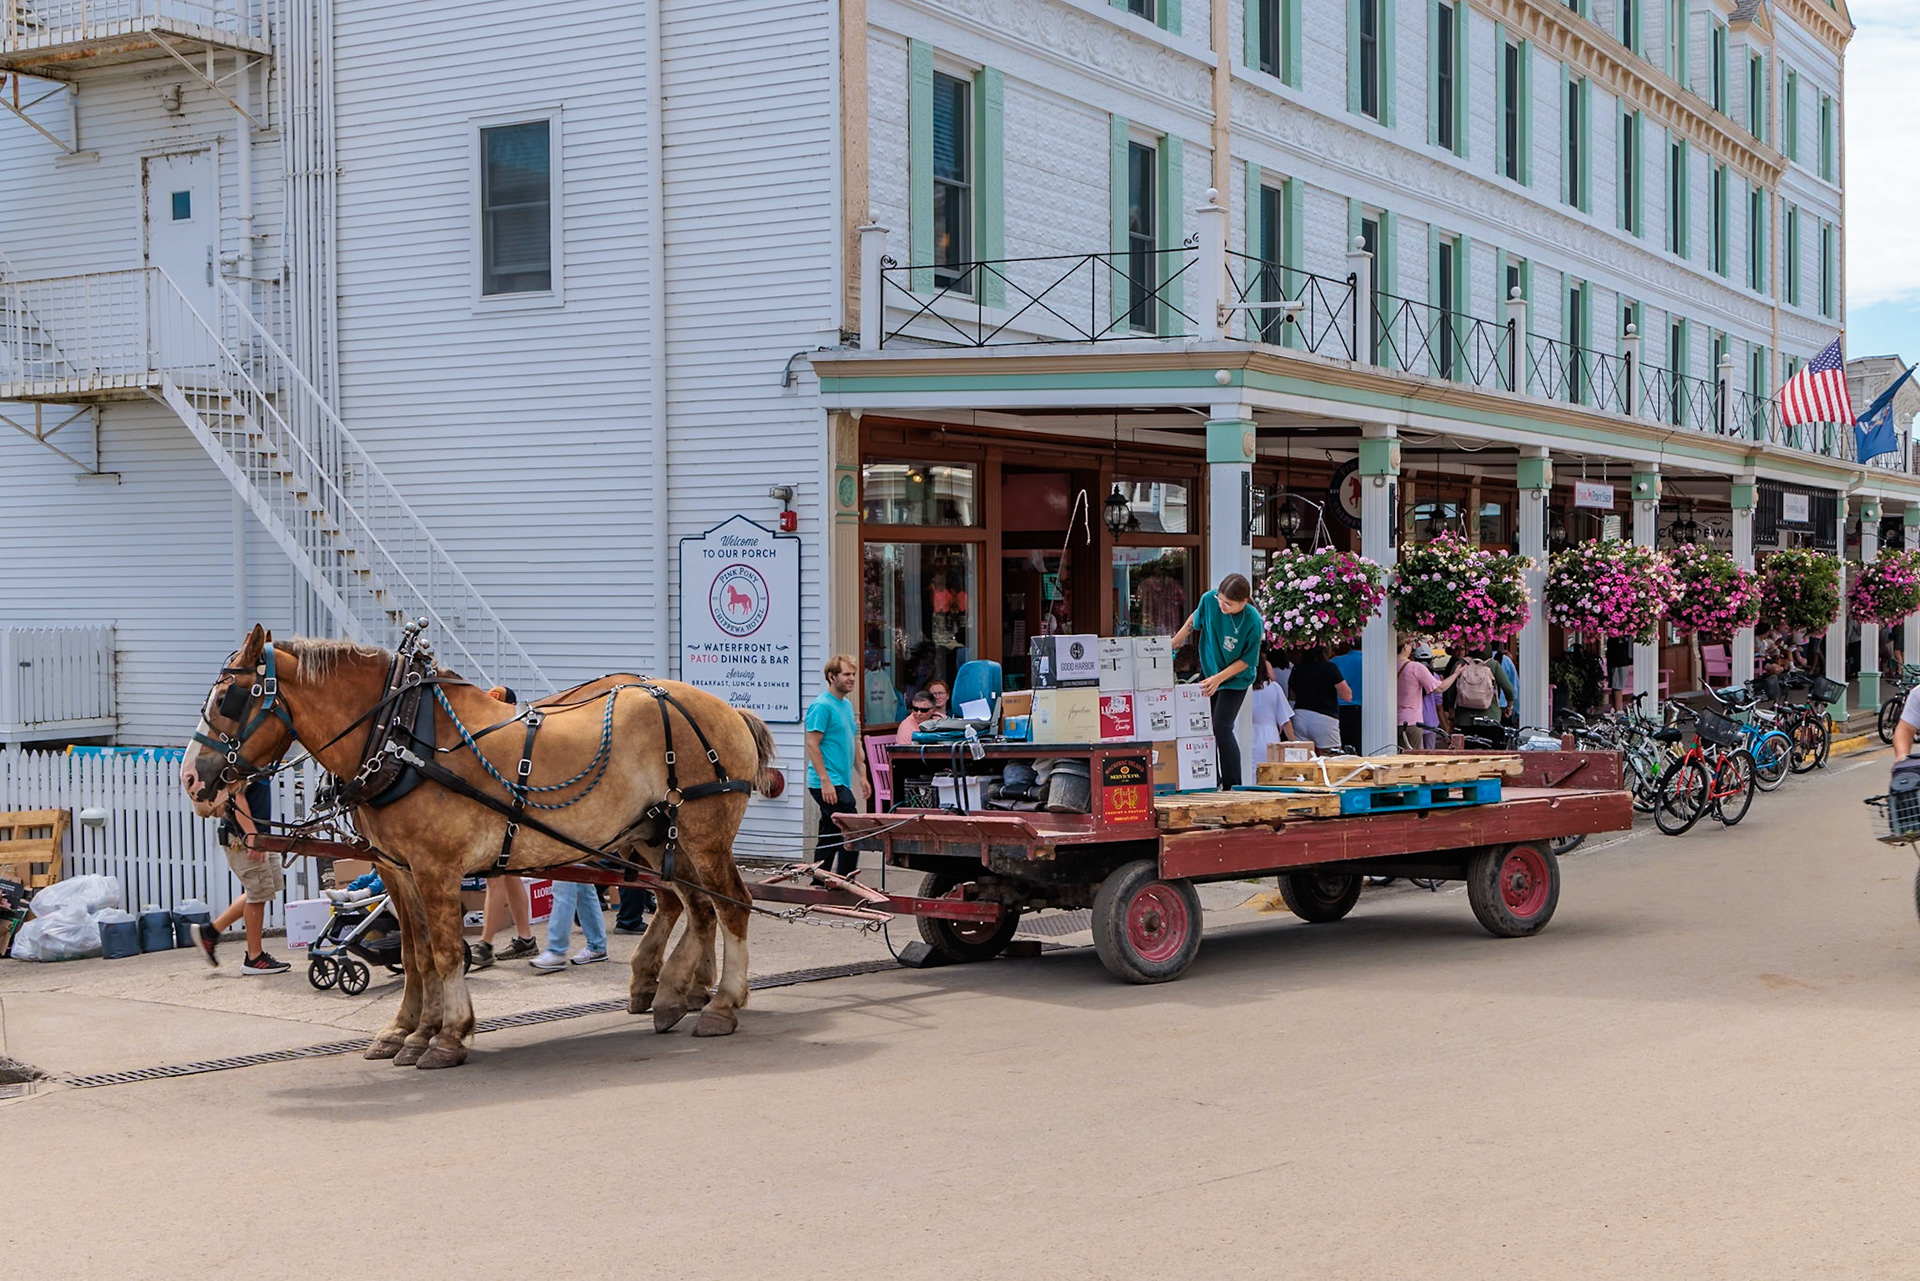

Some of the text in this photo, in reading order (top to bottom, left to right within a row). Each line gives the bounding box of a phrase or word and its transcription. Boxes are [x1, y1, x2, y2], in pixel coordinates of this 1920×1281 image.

[720, 535, 760, 546] Welcome
[702, 549, 776, 558] TO OUR PORCH
[719, 567, 759, 584] PINK PONY
[714, 608, 764, 632] CHIPPEWA HOTEL
[704, 643, 772, 652] WATERFRONT
[690, 654, 790, 664] PATIO DINING & BAR
[1060, 662, 1095, 672] GOOD HARBOR
[726, 668, 755, 681] Serving
[692, 680, 730, 688] BREAKFAST,
[729, 692, 752, 704] Daily
